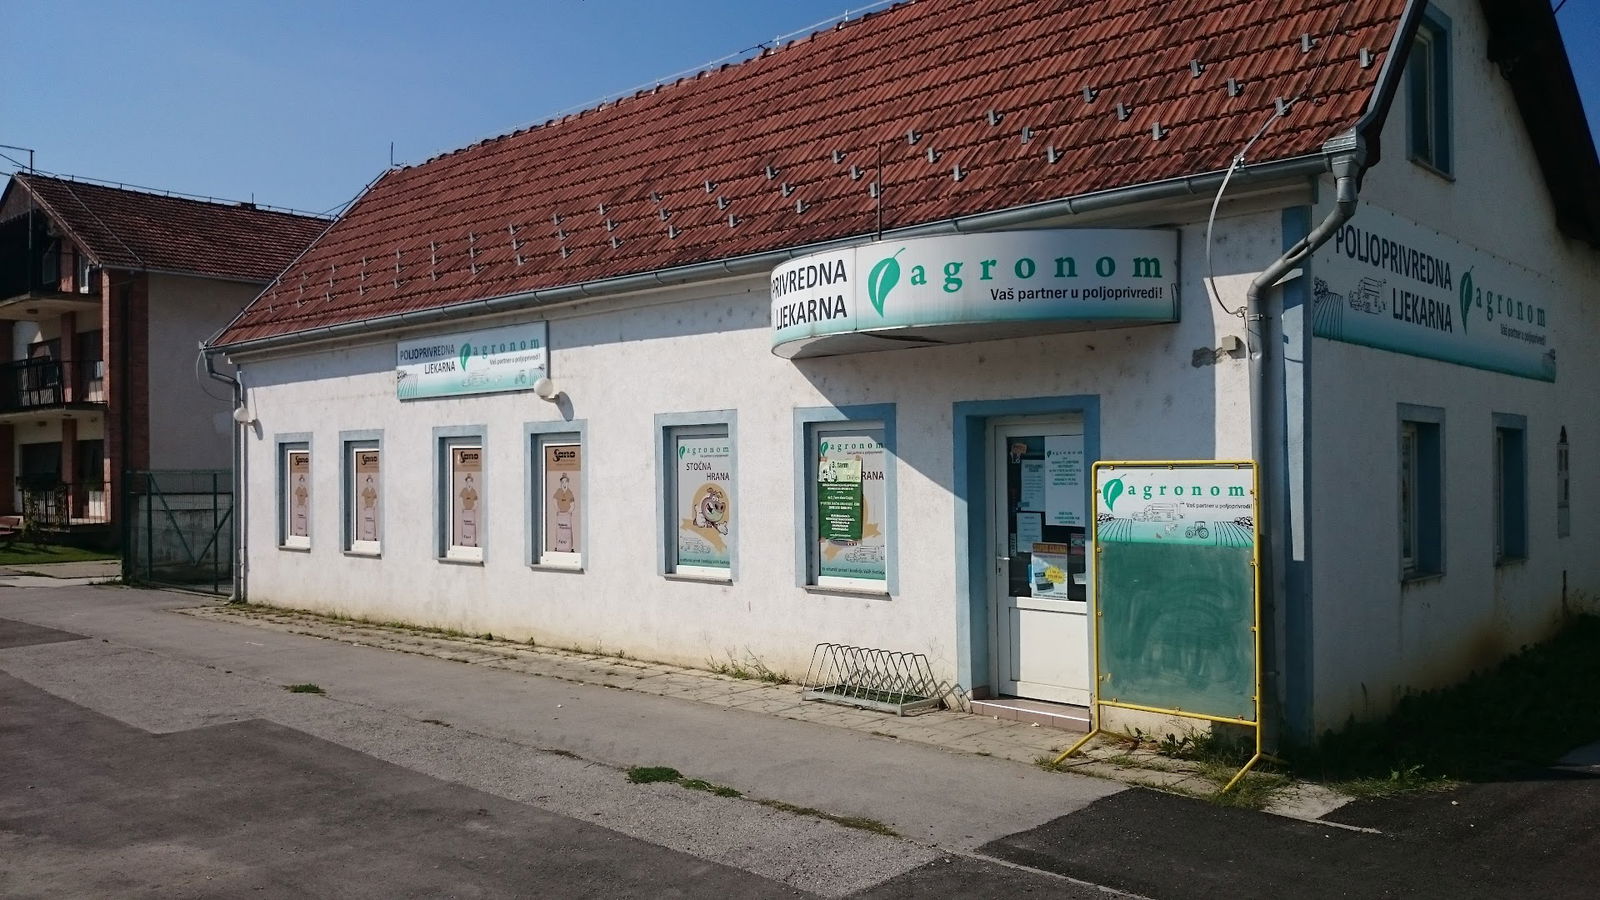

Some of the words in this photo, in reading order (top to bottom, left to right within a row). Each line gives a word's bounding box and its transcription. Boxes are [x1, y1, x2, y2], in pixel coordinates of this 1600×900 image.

[1336, 224, 1453, 291] POLJOPRIVREDNA
[910, 256, 1163, 293] agronom
[990, 287, 1014, 301] Vaš
[1018, 288, 1068, 302] partner
[1071, 288, 1079, 299] u
[1082, 285, 1163, 301] poljoprivredi!
[776, 294, 848, 331] LJEKARNA
[1392, 287, 1453, 334] LJEKARNA
[1476, 286, 1546, 328] agronom
[400, 344, 455, 361] POLJOPRIVREDNA
[473, 338, 540, 359] agronom
[424, 361, 456, 375] LJEKARNA
[552, 448, 576, 463] Sano
[830, 442, 884, 453] agronom
[460, 451, 479, 463] Sano
[706, 472, 730, 481] HRANA
[862, 471, 885, 480] RANA
[1128, 484, 1246, 500] agronom
